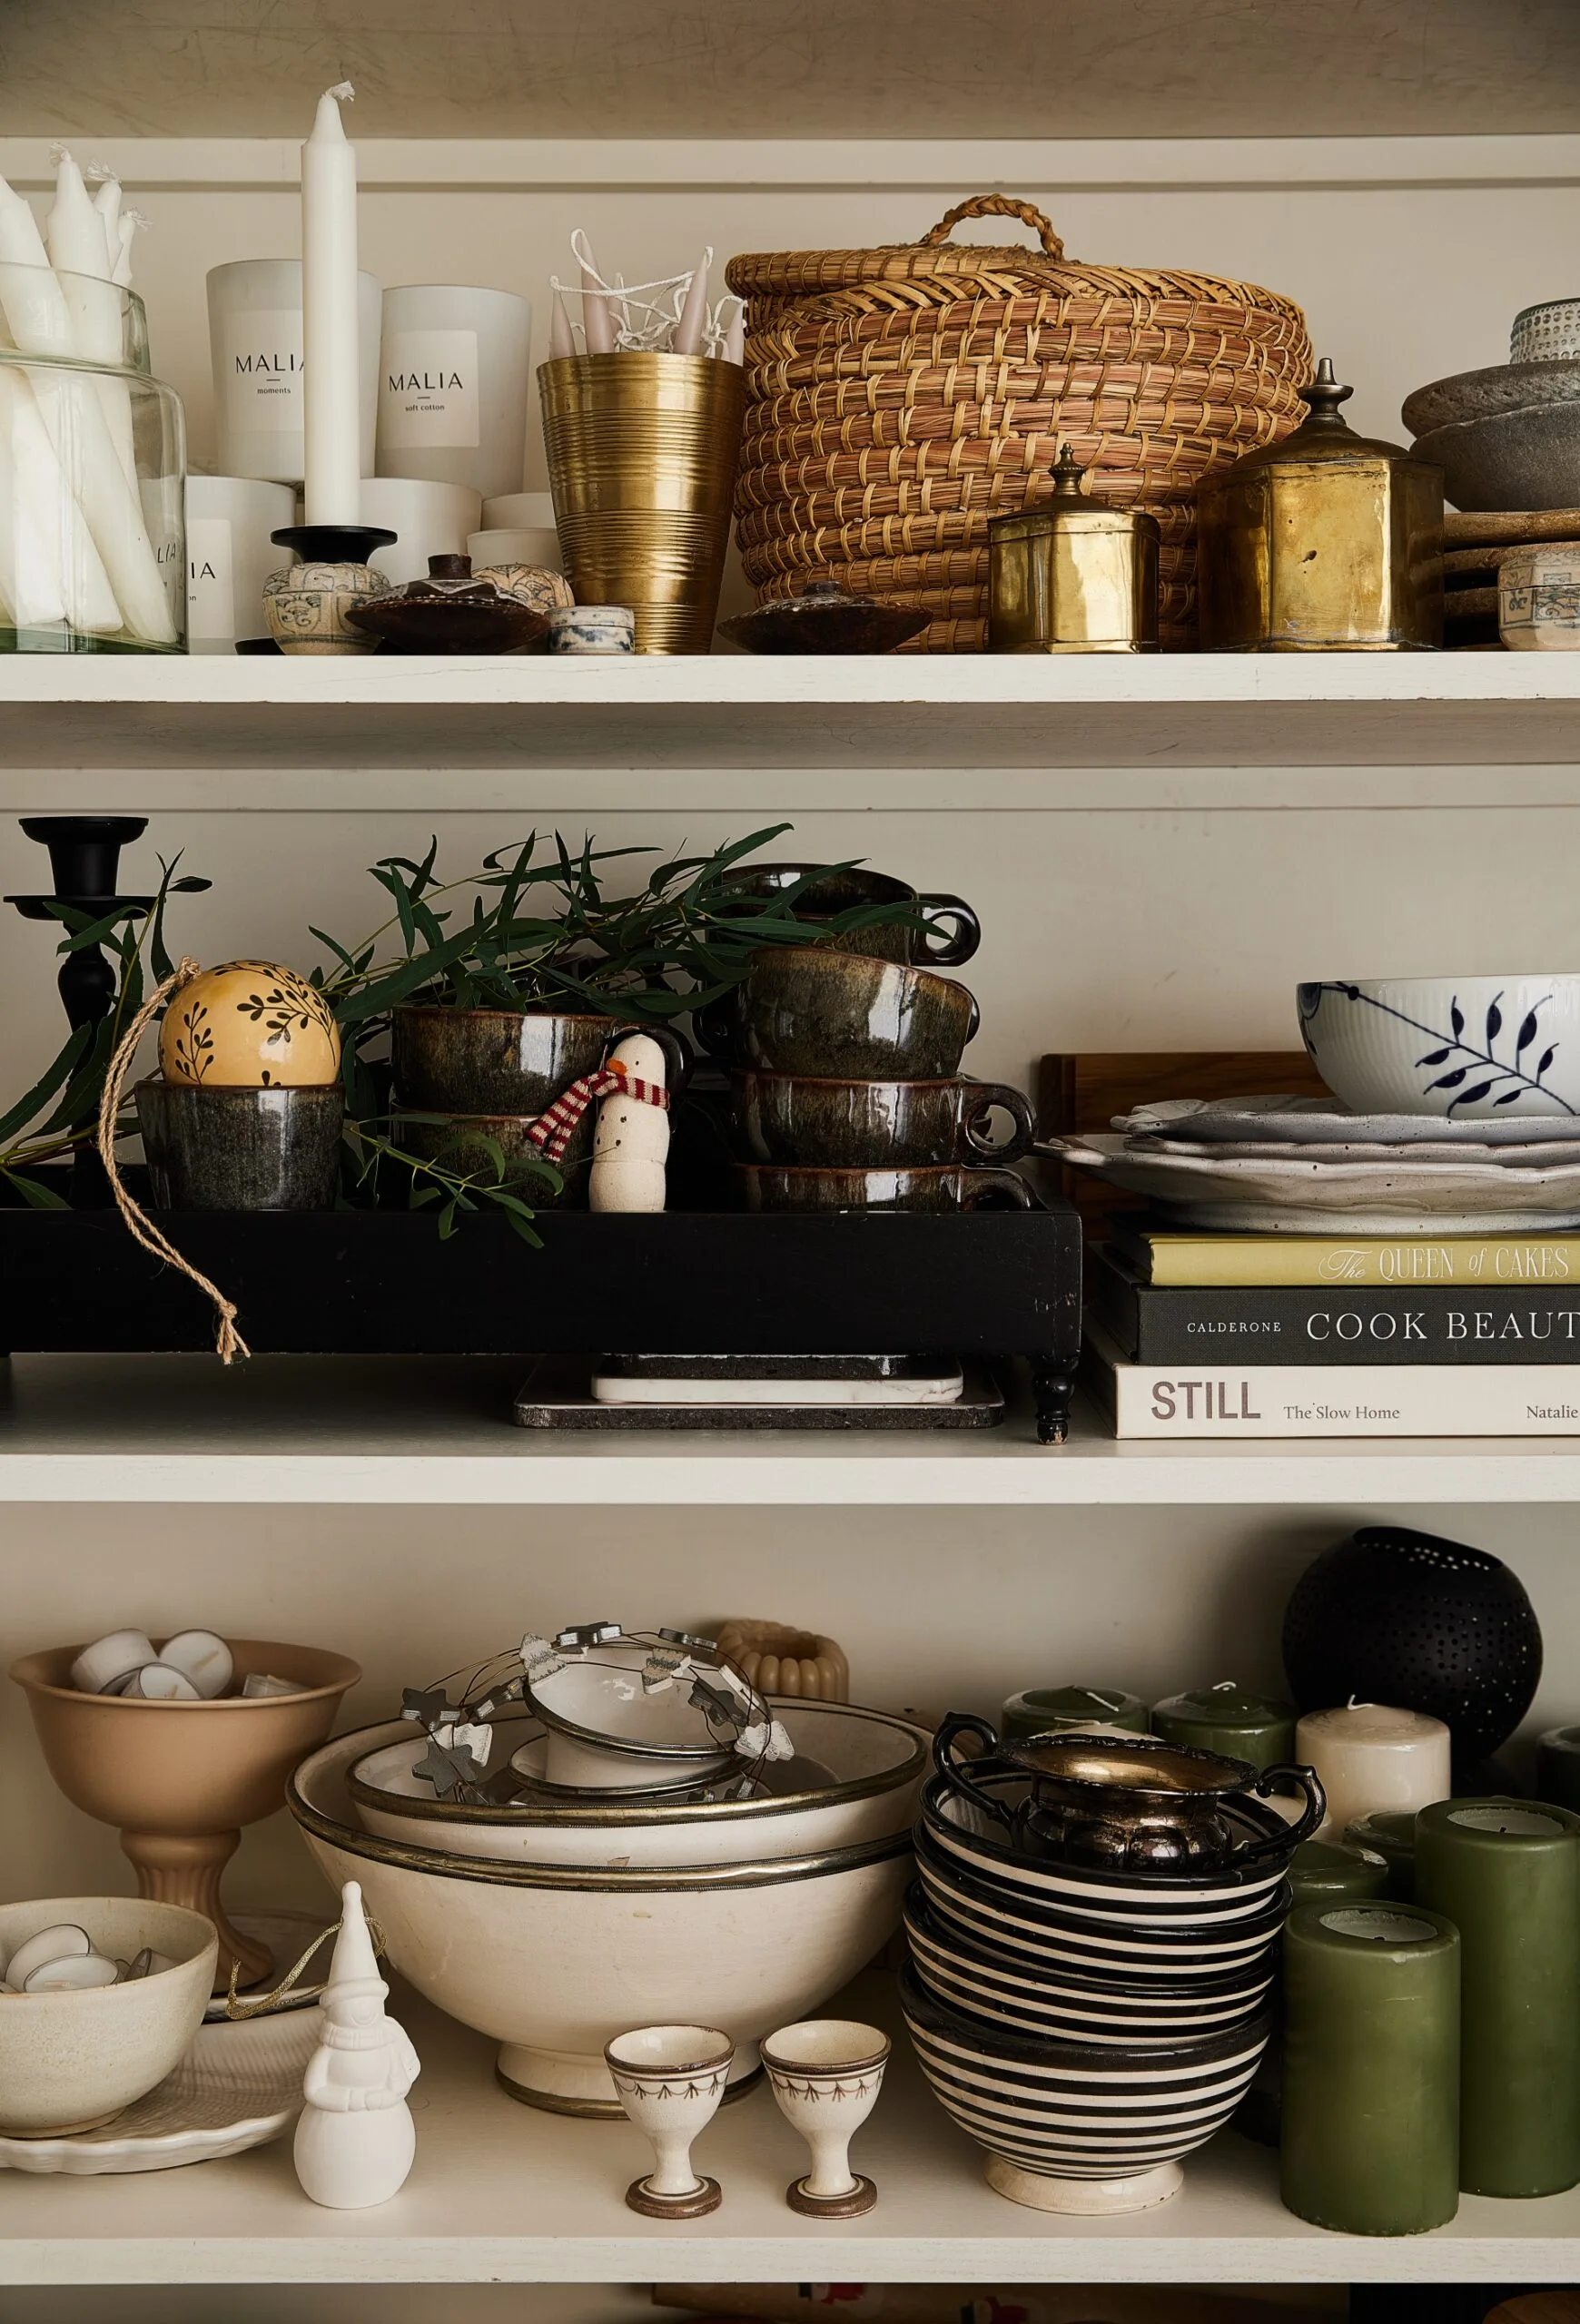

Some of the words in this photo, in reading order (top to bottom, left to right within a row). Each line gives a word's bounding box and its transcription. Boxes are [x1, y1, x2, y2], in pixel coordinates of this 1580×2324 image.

[389, 372, 463, 392] MALIA
[257, 387, 291, 395] moments
[405, 404, 419, 412] soft
[1318, 1249, 1372, 1279] The
[1379, 1248, 1454, 1281] QUEEN
[1468, 1248, 1487, 1276] of
[1496, 1247, 1569, 1278] CAKES
[1187, 1322, 1281, 1333] CALDERONE
[1307, 1313, 1427, 1340] COOK
[1447, 1312, 1580, 1339] BEAUT
[1151, 1381, 1261, 1420] STILL
[1283, 1405, 1312, 1419] The
[1316, 1405, 1351, 1419] Slow
[1355, 1405, 1400, 1419] Home
[1526, 1404, 1579, 1418] Natalie
